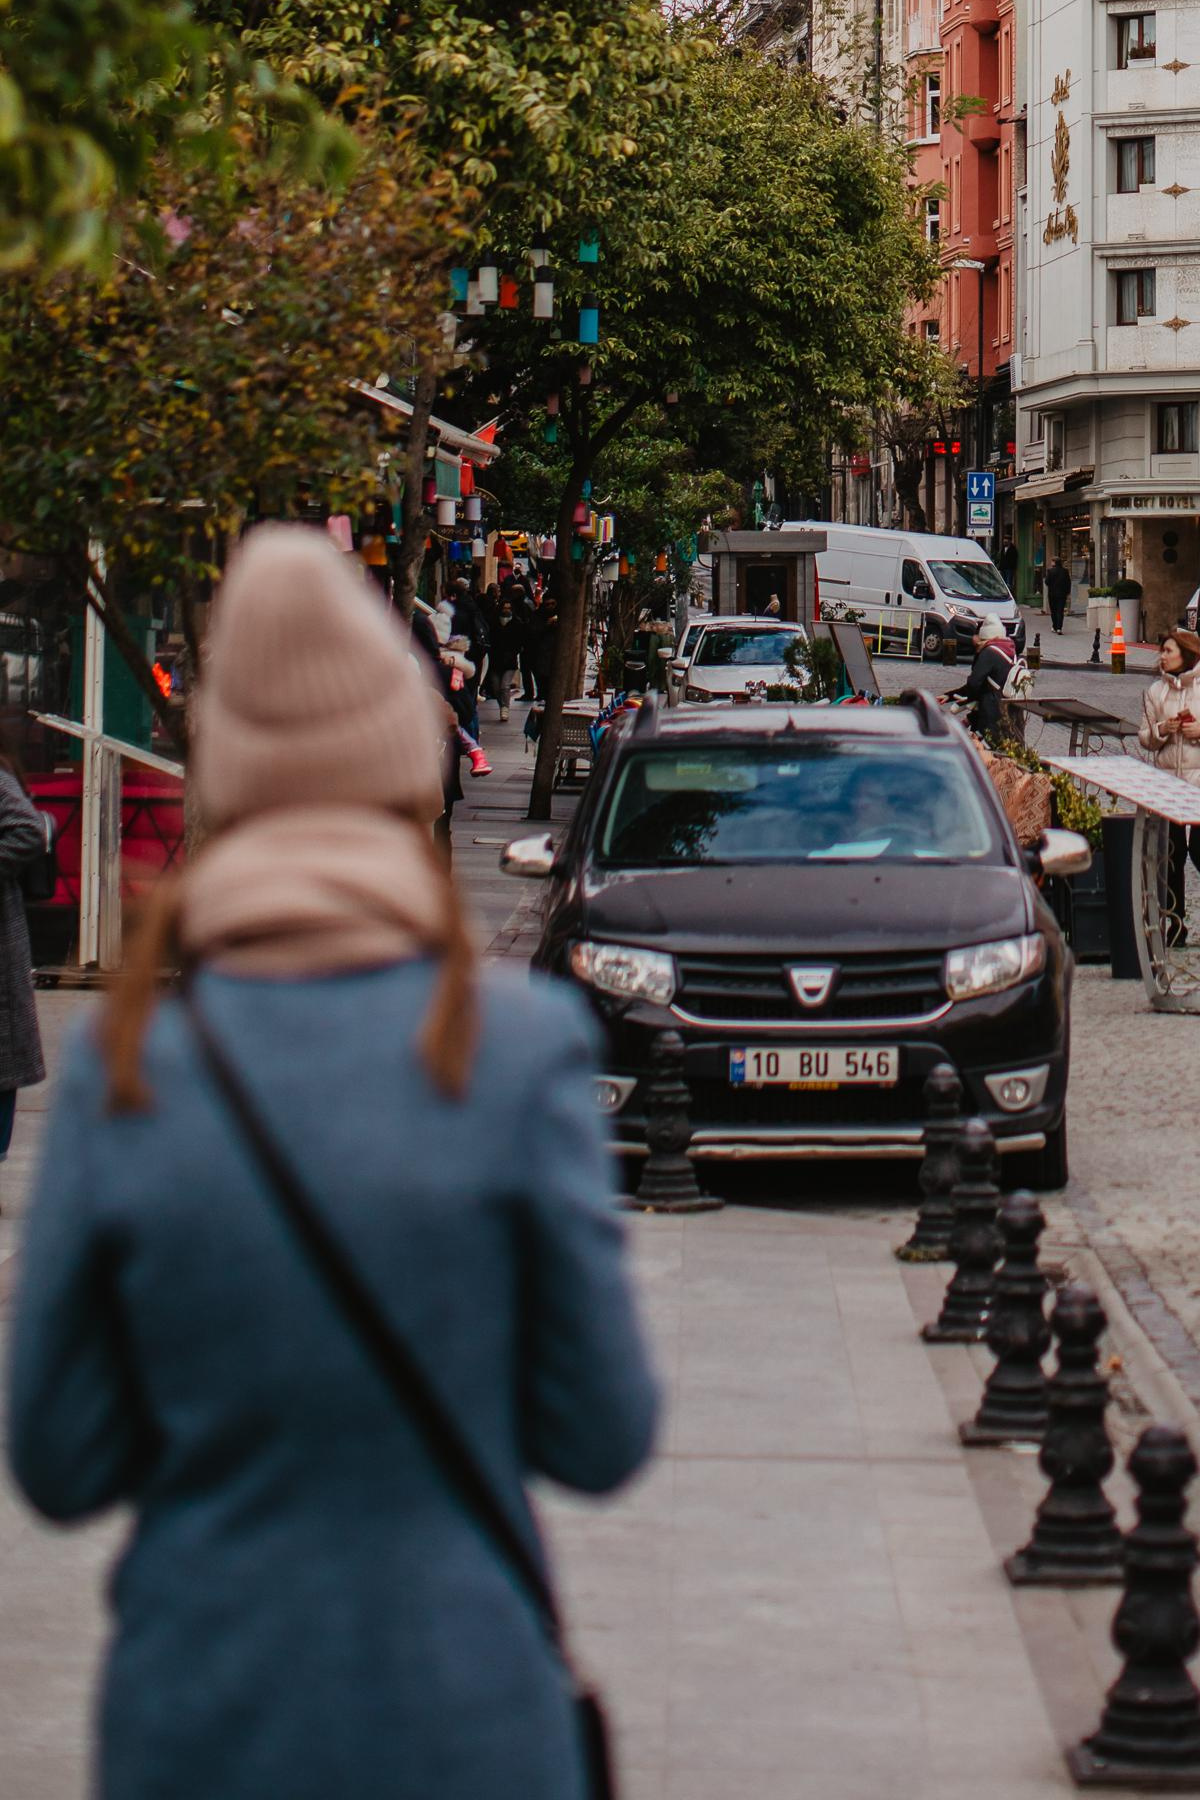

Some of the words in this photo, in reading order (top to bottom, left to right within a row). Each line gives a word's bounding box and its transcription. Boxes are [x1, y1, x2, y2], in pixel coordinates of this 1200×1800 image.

[753, 1052, 779, 1077] 10
[800, 1052, 829, 1077] BU
[845, 1052, 890, 1077] 546
